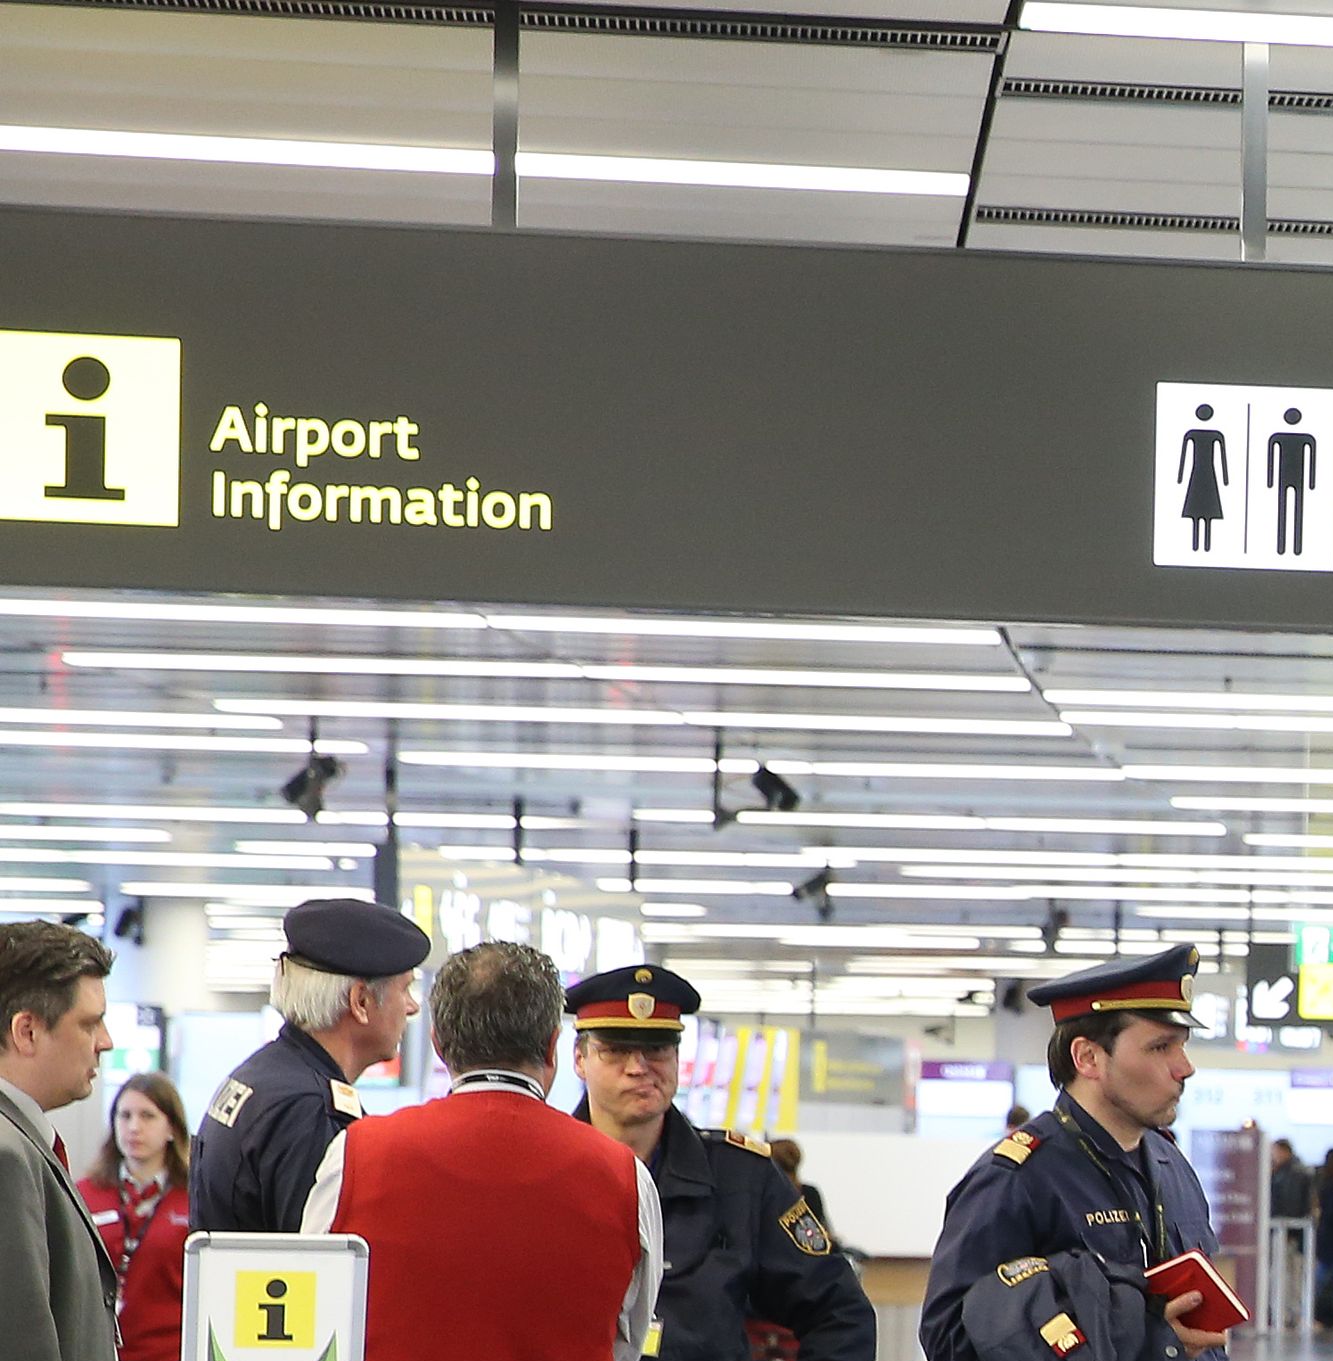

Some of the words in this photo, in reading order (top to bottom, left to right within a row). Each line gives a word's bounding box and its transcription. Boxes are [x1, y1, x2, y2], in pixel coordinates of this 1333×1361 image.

[210, 402, 420, 467] Airport
[212, 470, 553, 531] Information
[1086, 1209, 1130, 1227] POLIZEI
